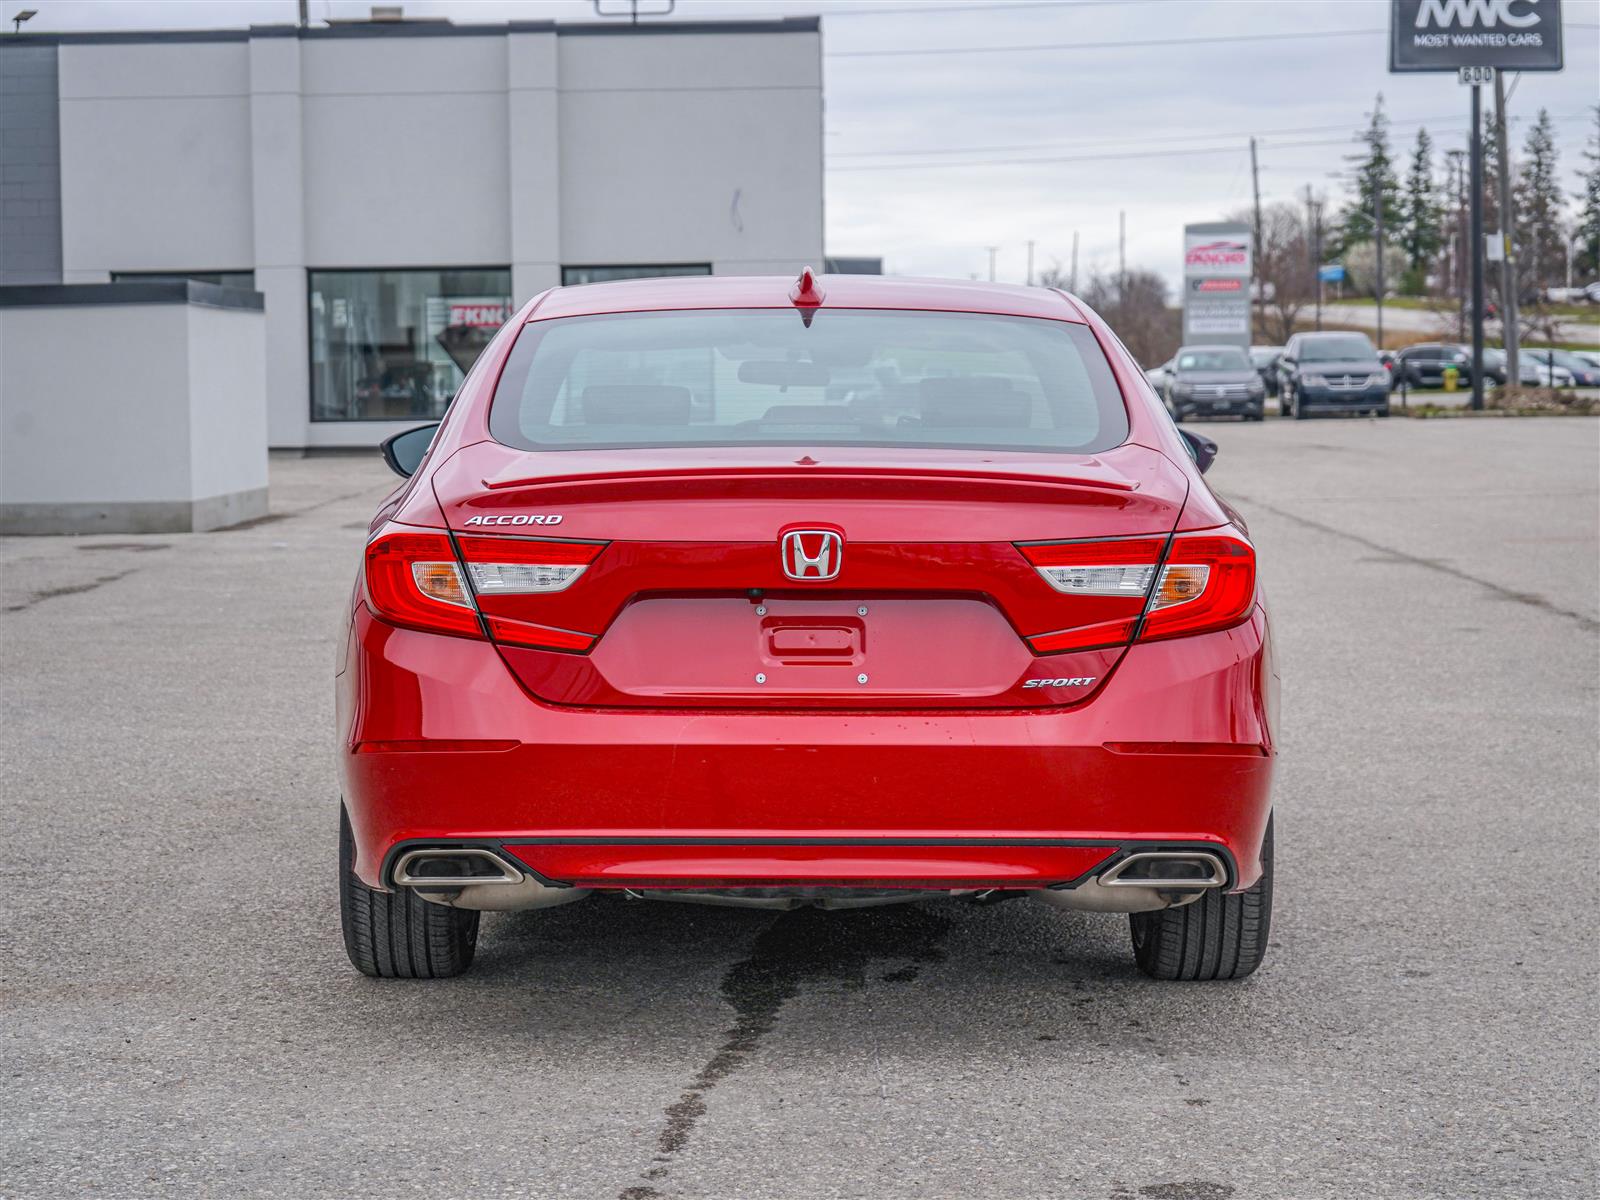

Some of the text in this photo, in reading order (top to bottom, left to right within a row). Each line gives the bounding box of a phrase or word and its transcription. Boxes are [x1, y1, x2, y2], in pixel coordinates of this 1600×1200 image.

[1414, 33, 1543, 46] MOST WANTED CARS
[464, 515, 563, 525] ACCORD
[1022, 677, 1096, 688] SPORT
